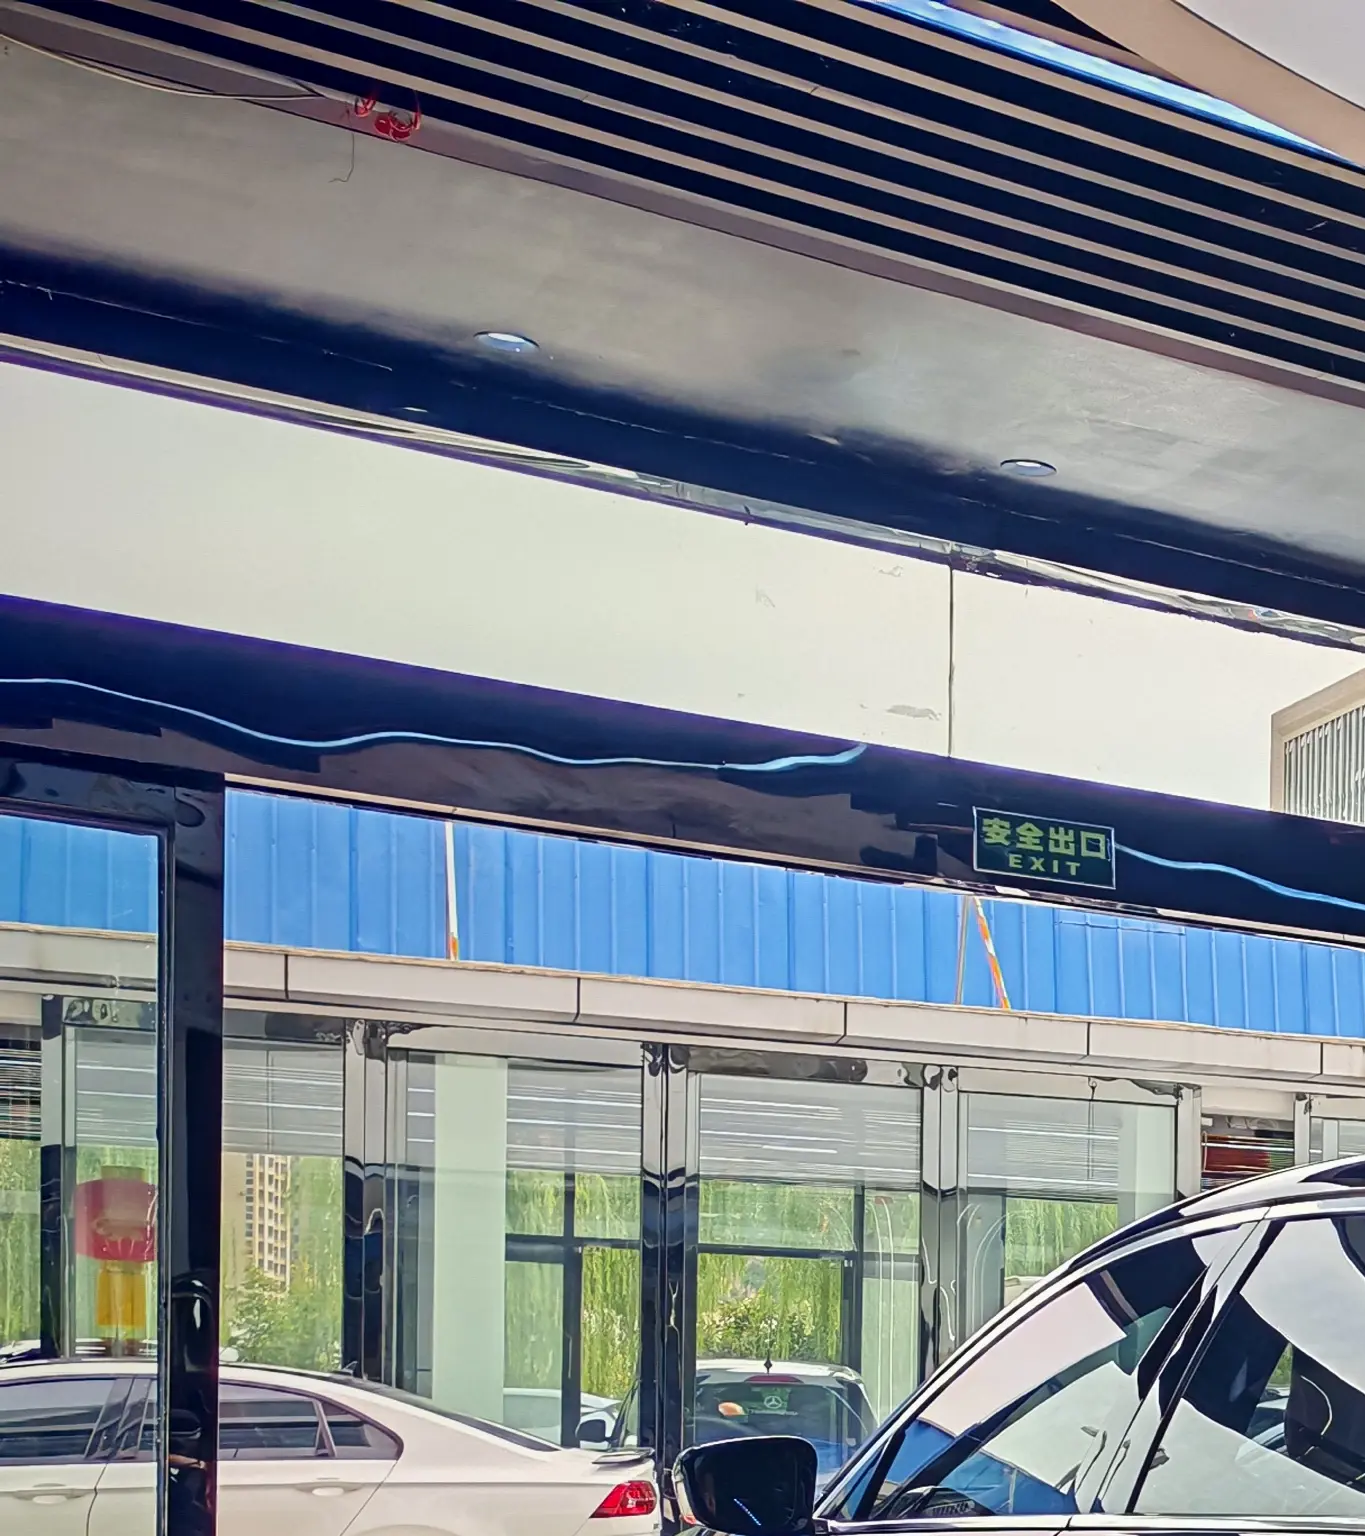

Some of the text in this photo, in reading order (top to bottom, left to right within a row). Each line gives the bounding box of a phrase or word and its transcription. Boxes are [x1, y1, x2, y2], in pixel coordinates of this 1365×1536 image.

[982, 817, 1107, 861] 安全出口
[1008, 853, 1082, 876] EXIT
